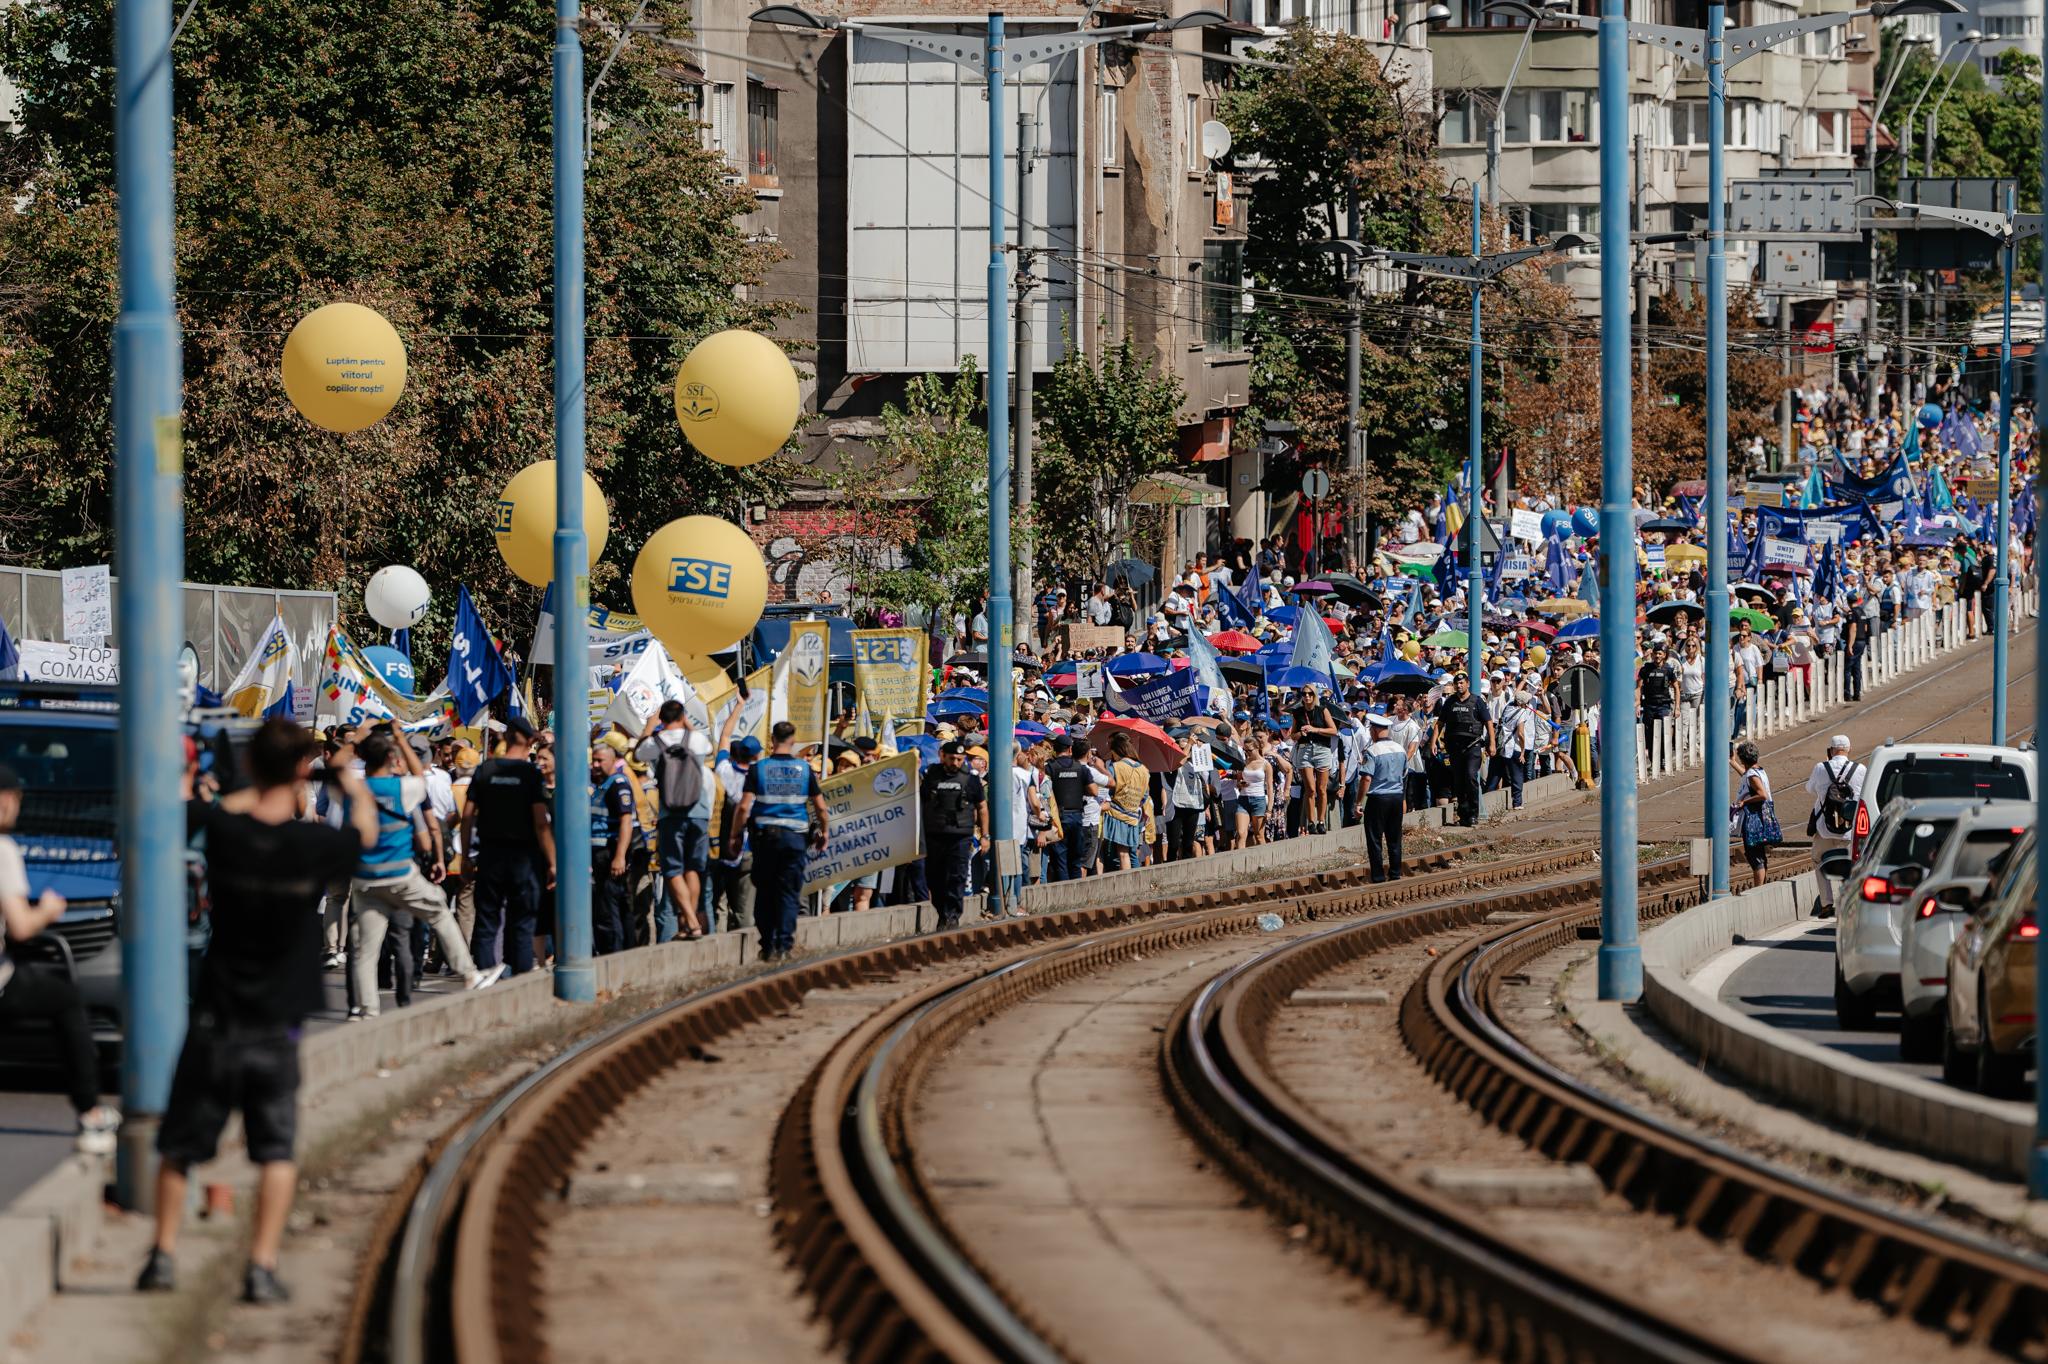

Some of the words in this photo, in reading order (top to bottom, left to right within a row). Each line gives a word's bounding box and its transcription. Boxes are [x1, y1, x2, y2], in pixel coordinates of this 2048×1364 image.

[360, 358, 385, 366] pentru
[341, 371, 373, 379] viitorul
[326, 385, 358, 393] copiilor
[495, 505, 512, 528] SE
[1503, 560, 1527, 571] MISIA
[668, 561, 730, 594] FSE
[69, 646, 112, 663] STOP
[604, 638, 648, 658] SIB
[386, 662, 415, 679] FSL
[1141, 686, 1172, 701] UNIUNEA
[823, 784, 854, 800] NTEM
[829, 806, 906, 839] LARIAȚILOR
[804, 861, 843, 883] UREȘTI
[852, 846, 890, 868] ILFOV
